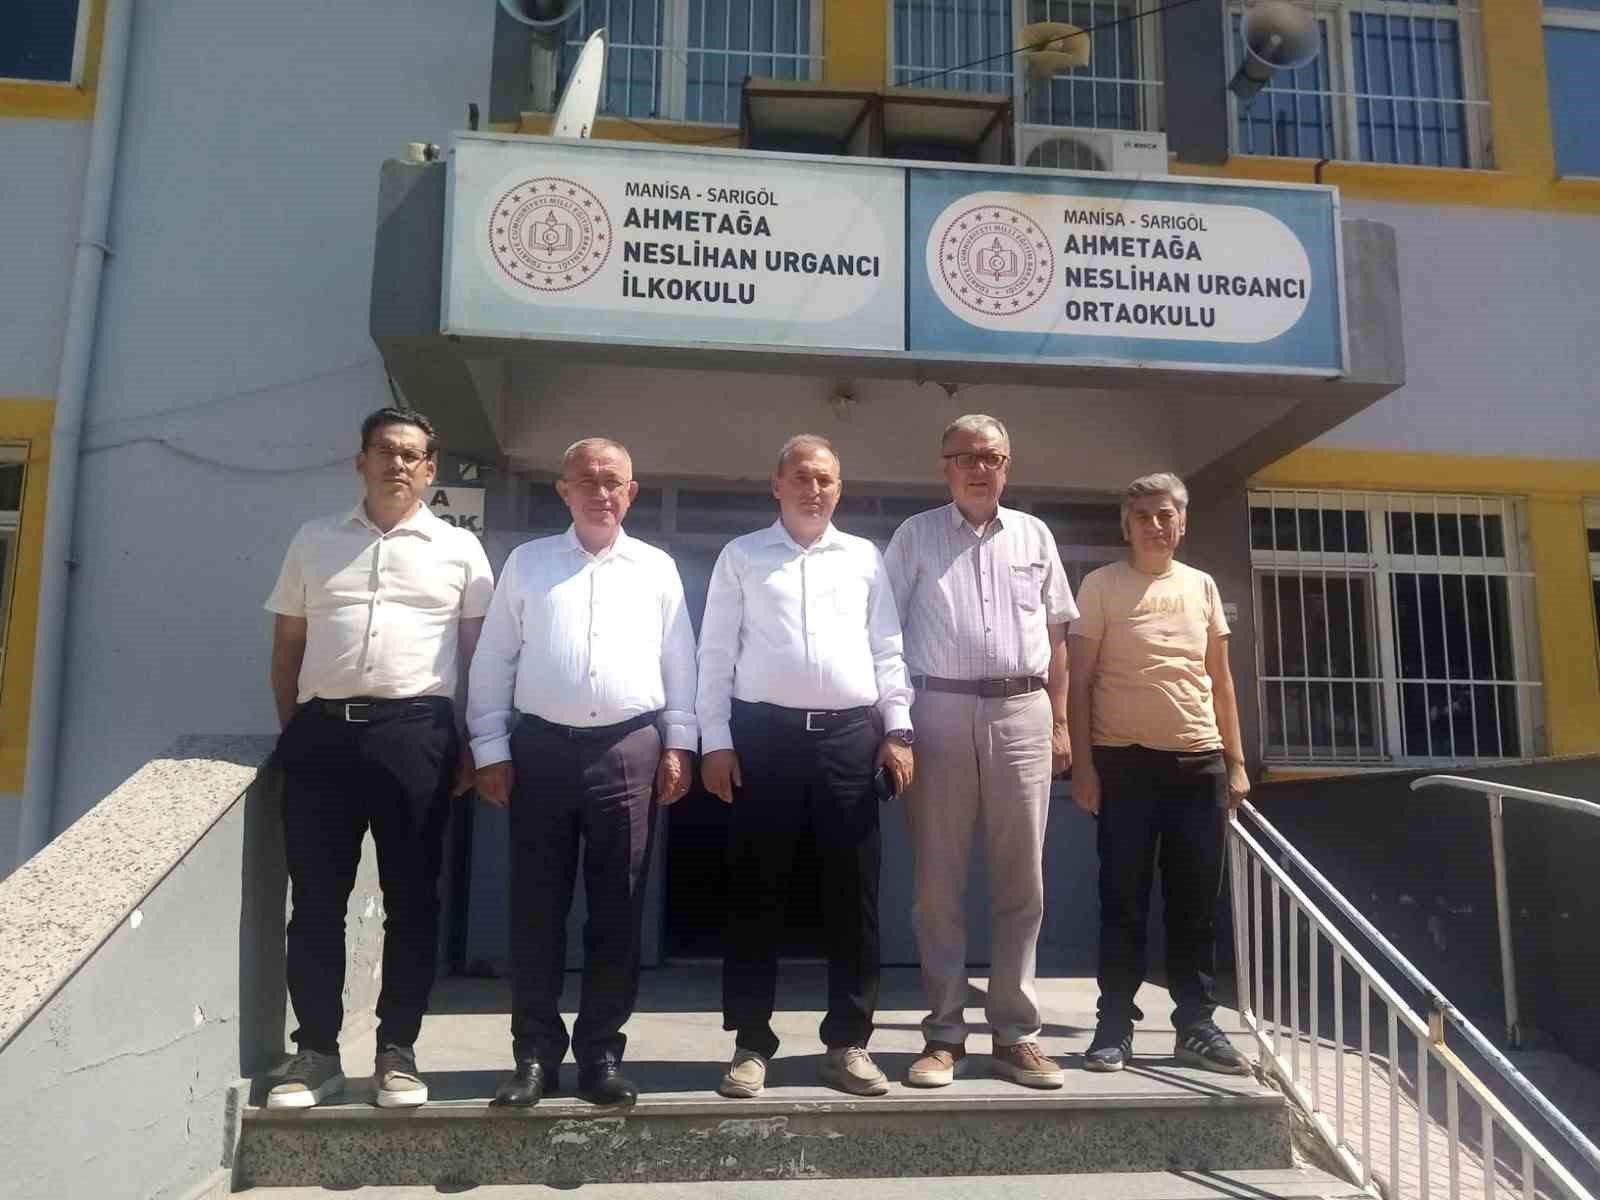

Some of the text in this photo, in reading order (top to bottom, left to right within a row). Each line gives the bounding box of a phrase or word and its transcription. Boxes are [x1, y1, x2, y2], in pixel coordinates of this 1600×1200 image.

[624, 181, 691, 200] MANİSA
[706, 187, 779, 206] SARIGÖL
[623, 207, 772, 237] AHMETAĞA
[1063, 207, 1126, 227] MANİSA
[1140, 213, 1208, 232] SARIGÖL
[623, 239, 880, 278] NESLİHAN URGANCI
[1063, 233, 1203, 262] AHMETAĞA
[622, 269, 756, 305] İLKOKULU
[1065, 264, 1306, 300] NESLİHAN URGANCI
[1065, 299, 1216, 329] ORTAOKULU
[430, 490, 449, 506] A
